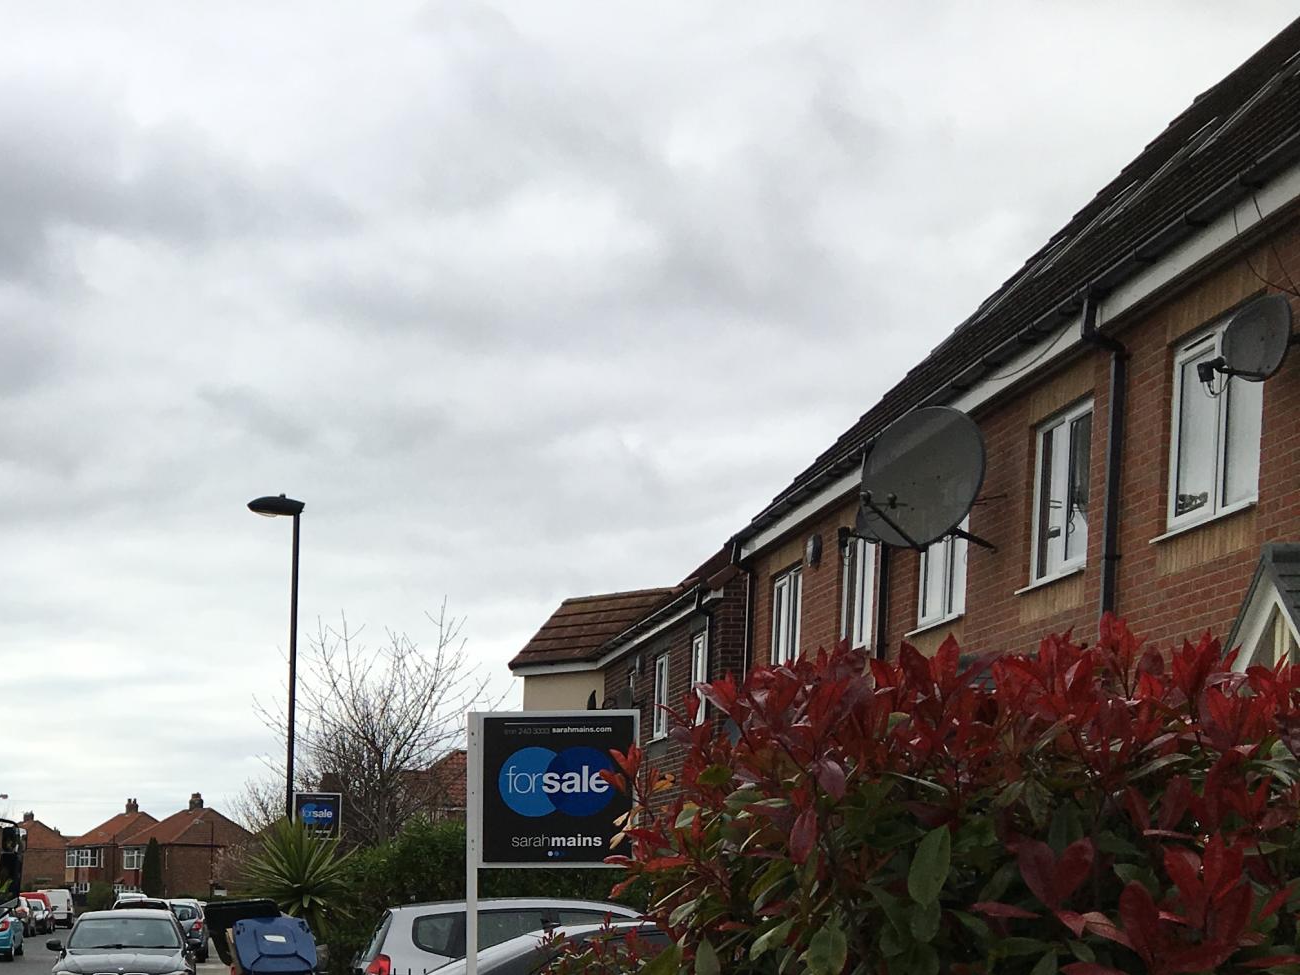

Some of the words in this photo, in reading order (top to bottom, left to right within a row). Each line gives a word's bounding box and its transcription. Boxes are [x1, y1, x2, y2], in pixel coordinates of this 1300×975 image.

[552, 726, 612, 734] sarahmains.com
[505, 765, 609, 794] forsale
[511, 833, 603, 848] sarahmains
